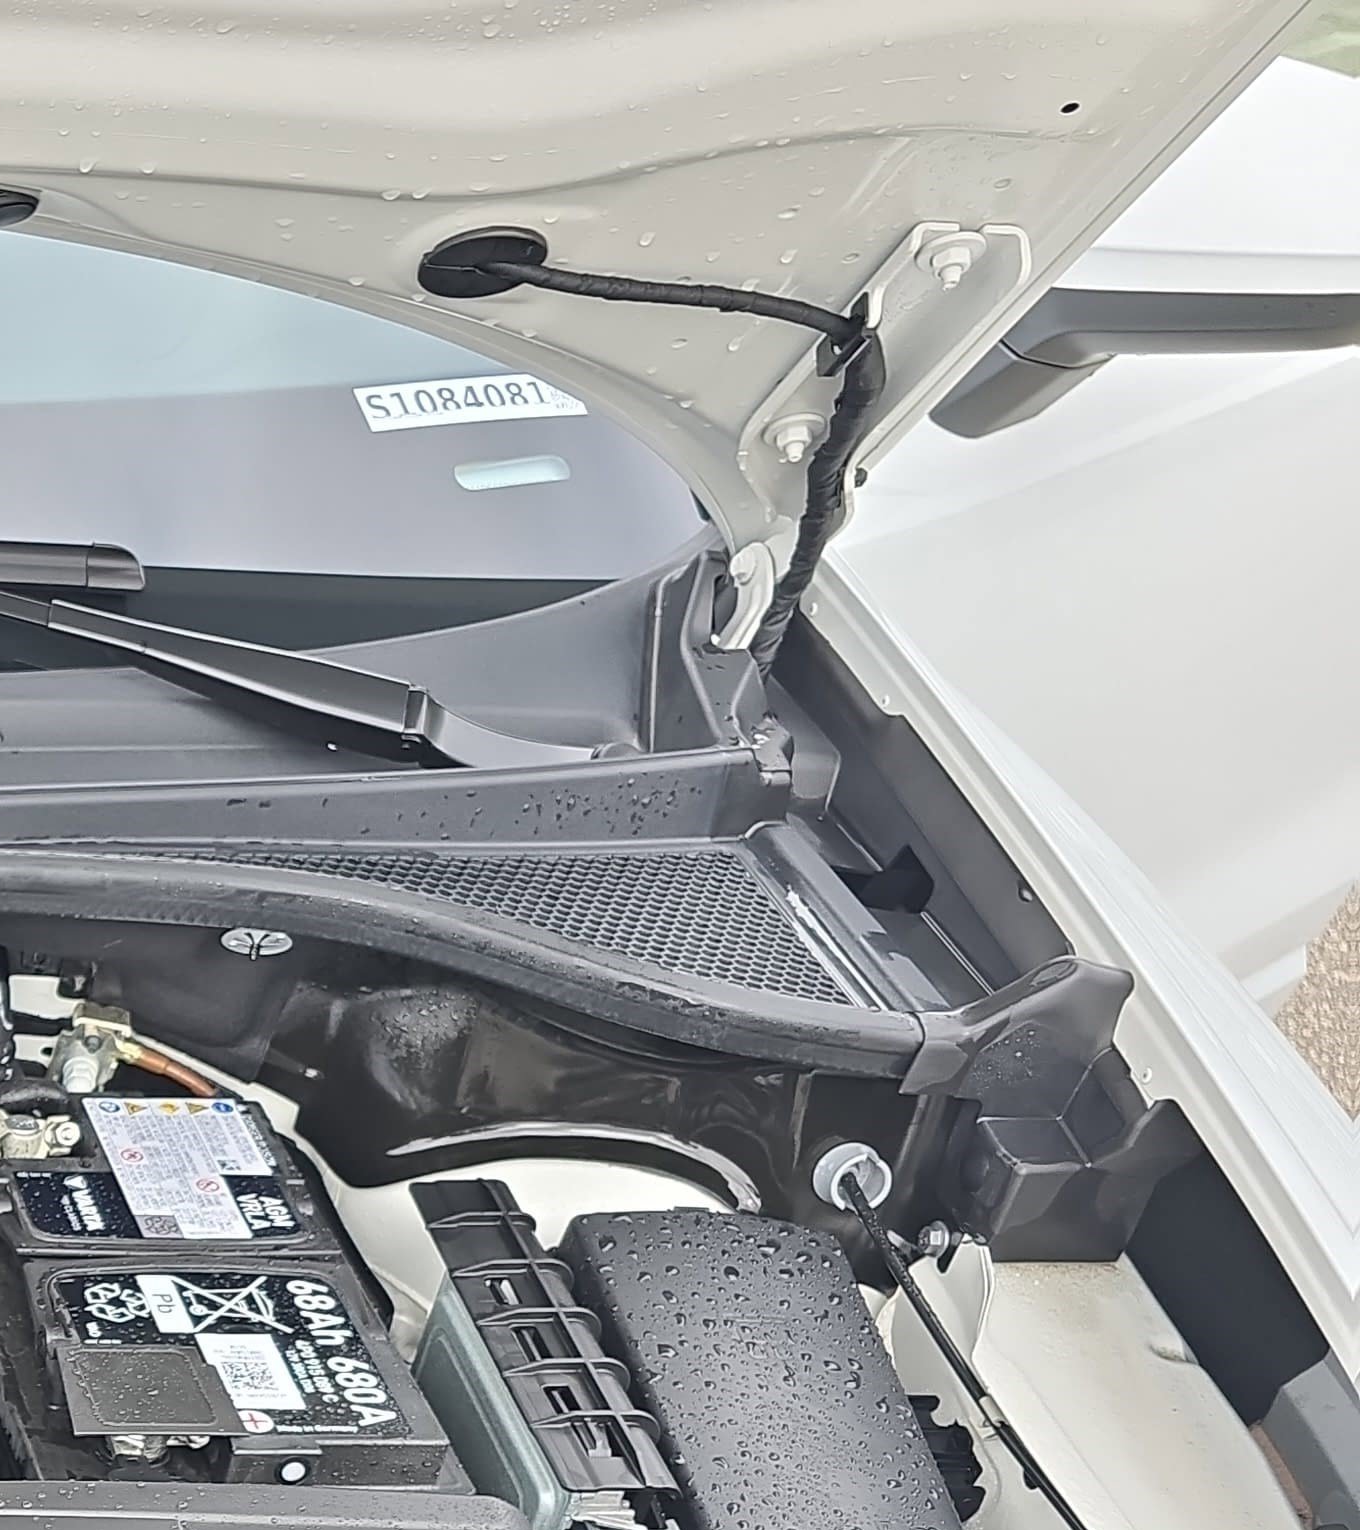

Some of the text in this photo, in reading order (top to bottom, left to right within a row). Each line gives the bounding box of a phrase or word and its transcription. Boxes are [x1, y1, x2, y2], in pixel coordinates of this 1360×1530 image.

[365, 381, 550, 419] S1084081
[237, 1193, 272, 1230] VRLA
[152, 1293, 173, 1314] Pb
[286, 1280, 397, 1426] 68Ah 680A
